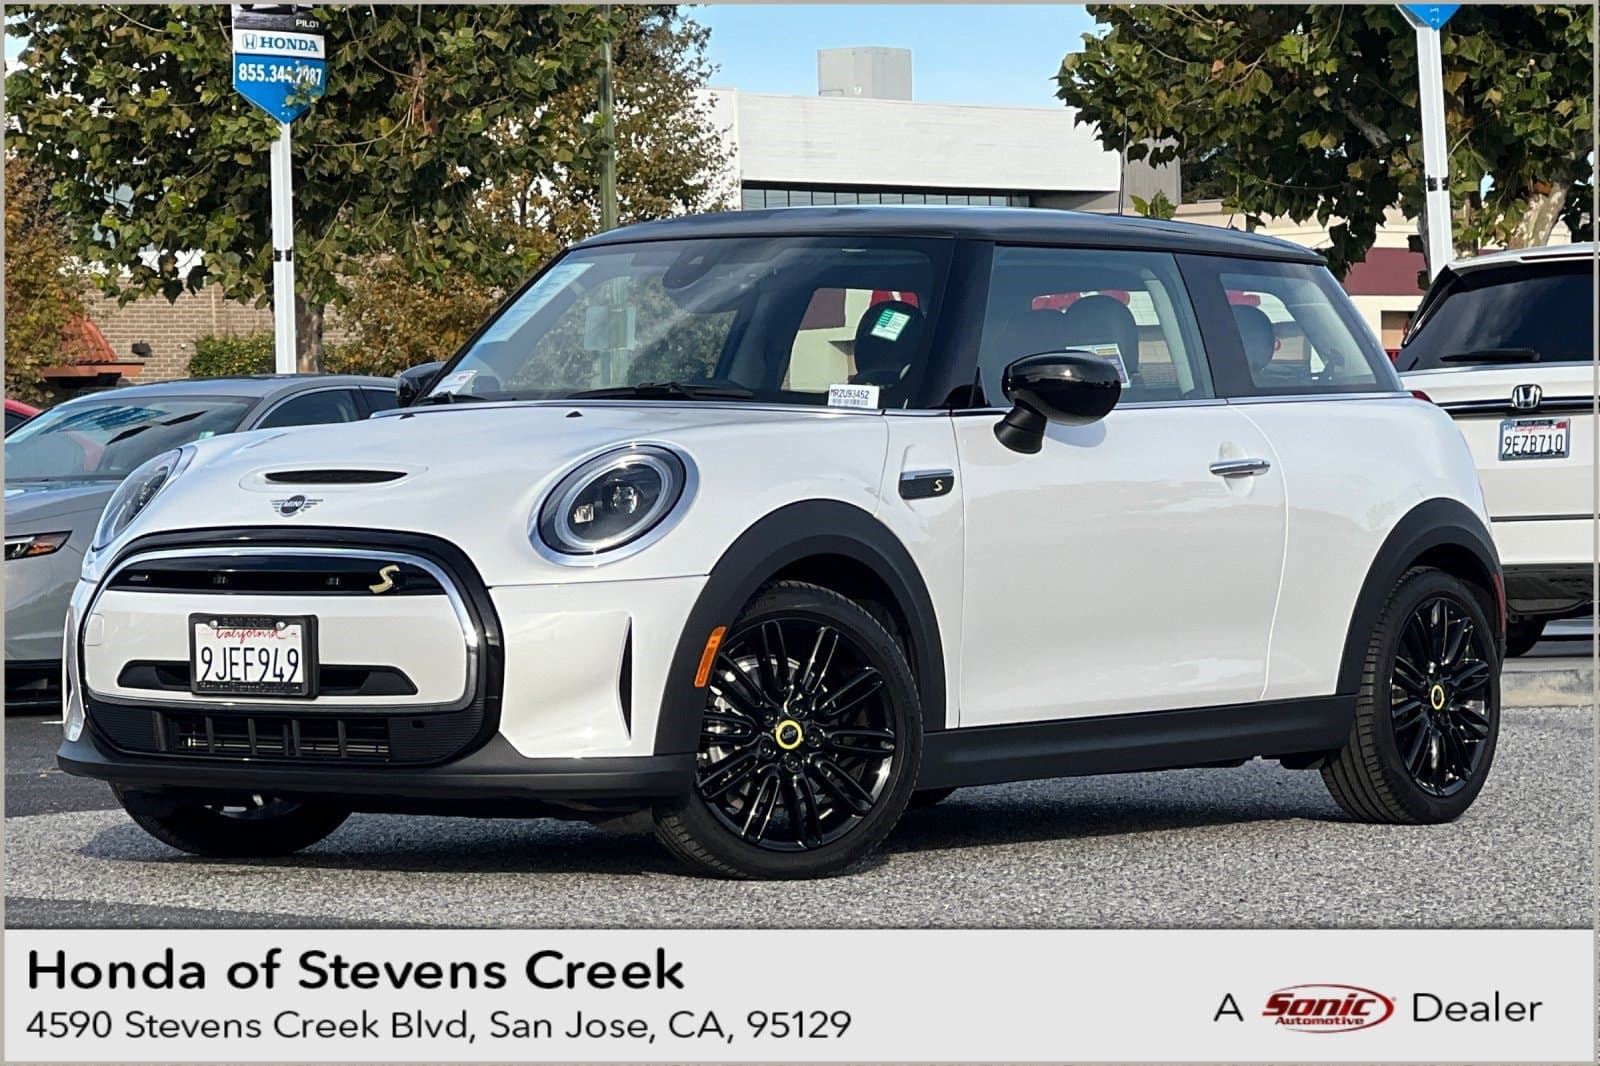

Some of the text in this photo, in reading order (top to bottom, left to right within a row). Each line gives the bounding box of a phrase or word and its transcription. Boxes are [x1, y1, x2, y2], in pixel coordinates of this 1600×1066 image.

[259, 36, 319, 52] HONDA
[1504, 434, 1564, 454] 9EZB710
[933, 479, 944, 492] S
[368, 564, 400, 594] S
[215, 627, 288, 645] California
[200, 646, 300, 683] 9JEF949
